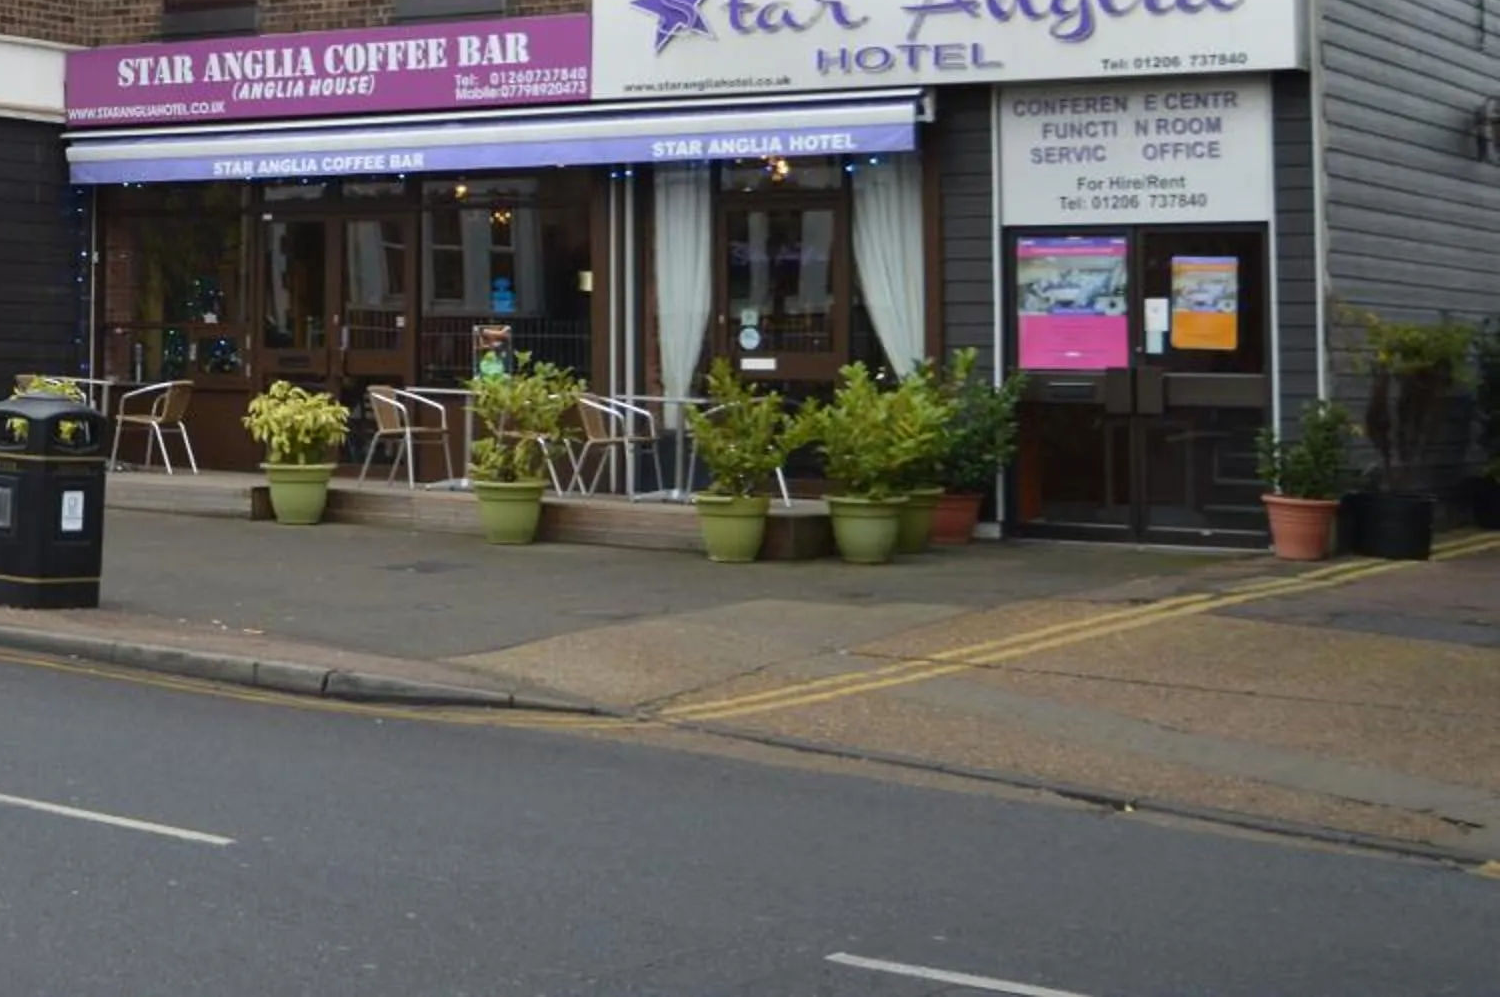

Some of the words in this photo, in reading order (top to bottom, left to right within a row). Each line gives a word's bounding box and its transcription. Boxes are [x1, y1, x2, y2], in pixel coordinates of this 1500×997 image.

[117, 55, 195, 87] STAR
[203, 47, 316, 83] ANGLIA
[323, 37, 448, 76] COFFEE
[457, 32, 530, 67] BAR
[814, 41, 1004, 76] HOTEL
[1100, 57, 1129, 70] Tel:
[1133, 55, 1182, 69] 01206
[1188, 52, 1248, 67] 737840
[232, 79, 304, 101] (ANGLIA
[308, 74, 376, 97] HOUSE)
[1164, 90, 1239, 110] CENTR
[1155, 116, 1222, 135] ROOM
[653, 140, 703, 157] STAR
[707, 135, 783, 154] ANGLIA
[788, 133, 858, 150] HOTEL
[1141, 141, 1221, 161] OFFICE
[213, 160, 254, 175] STAR
[257, 157, 316, 174] ANGLIA
[321, 155, 386, 171] COFFEE
[389, 153, 424, 169] BAR
[1076, 177, 1105, 191] For
[1059, 196, 1086, 211] Tel:
[1091, 195, 1140, 209] 01206
[1148, 193, 1208, 209] 737840
